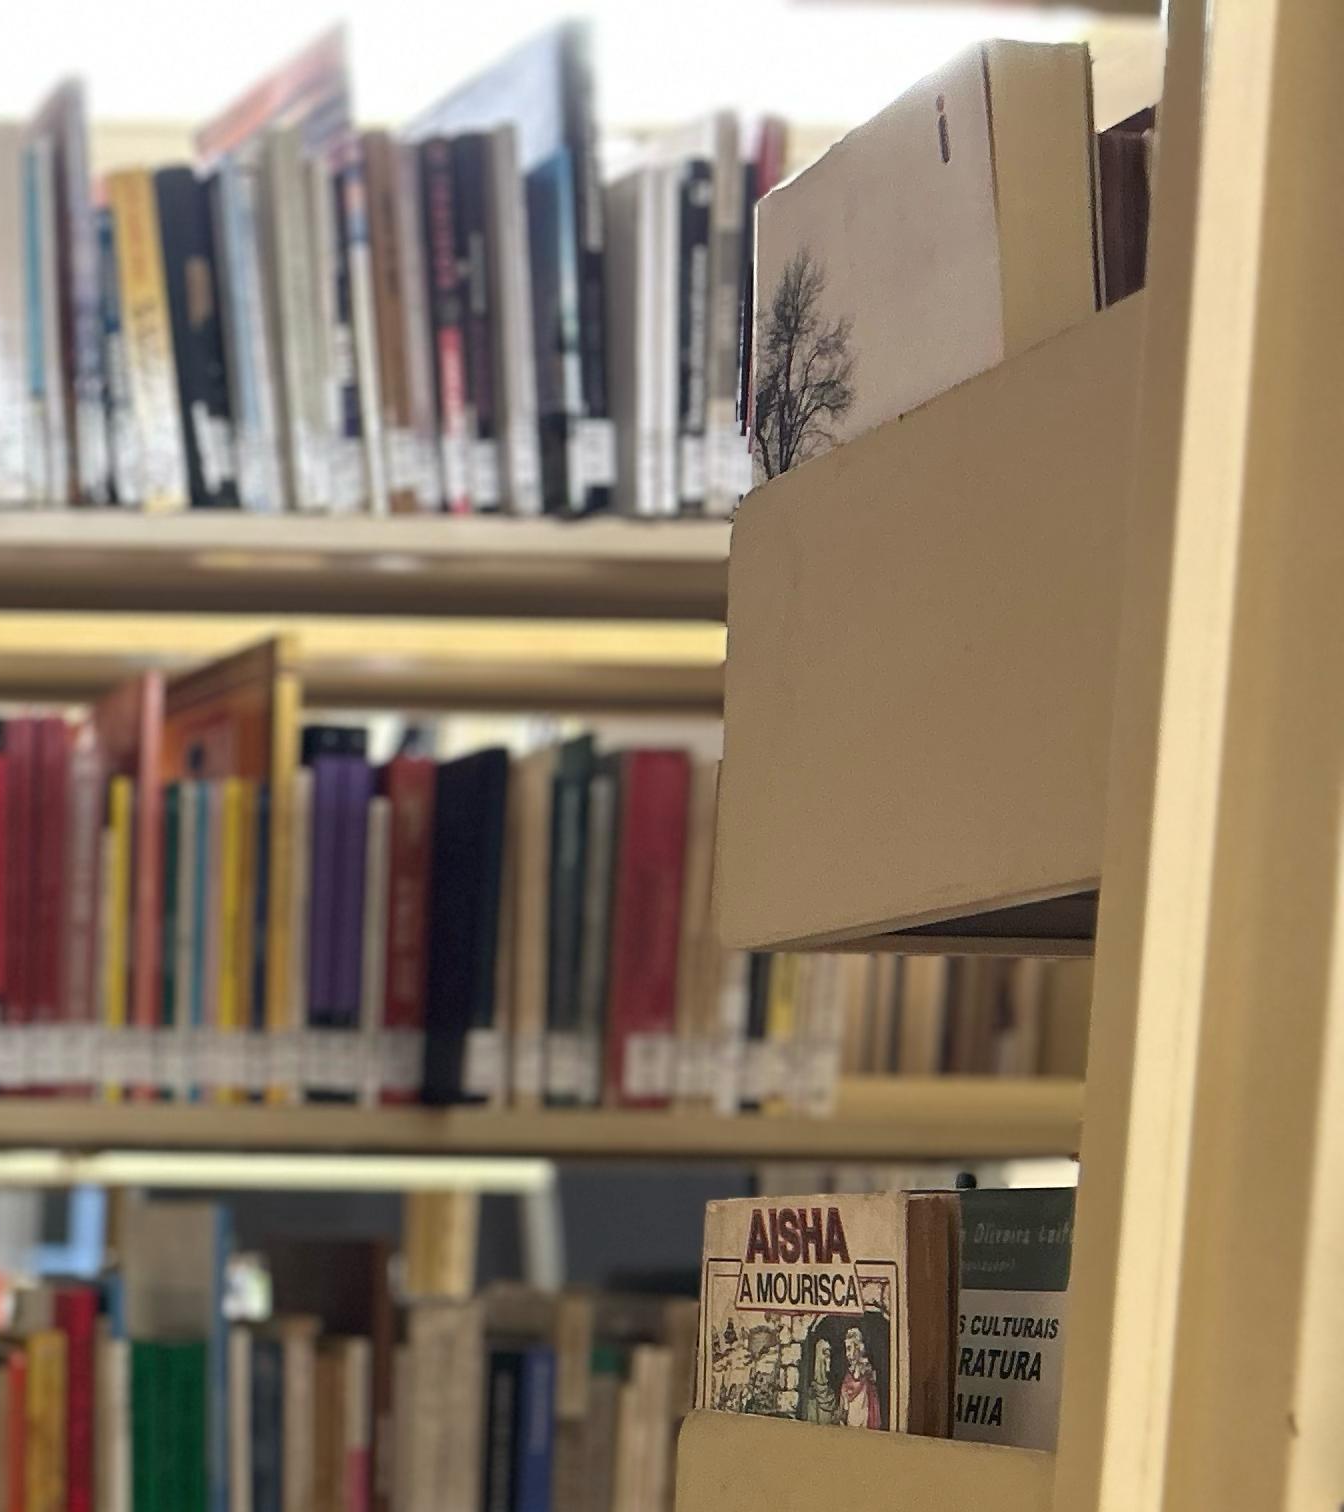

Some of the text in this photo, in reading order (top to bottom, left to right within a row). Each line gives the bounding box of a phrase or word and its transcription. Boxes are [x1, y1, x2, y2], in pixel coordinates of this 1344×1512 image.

[745, 1207, 851, 1264] AISHA
[739, 1272, 859, 1307] A MOURISCA
[971, 1315, 1060, 1339] CULTURAIS
[958, 1347, 1042, 1382] RATURA
